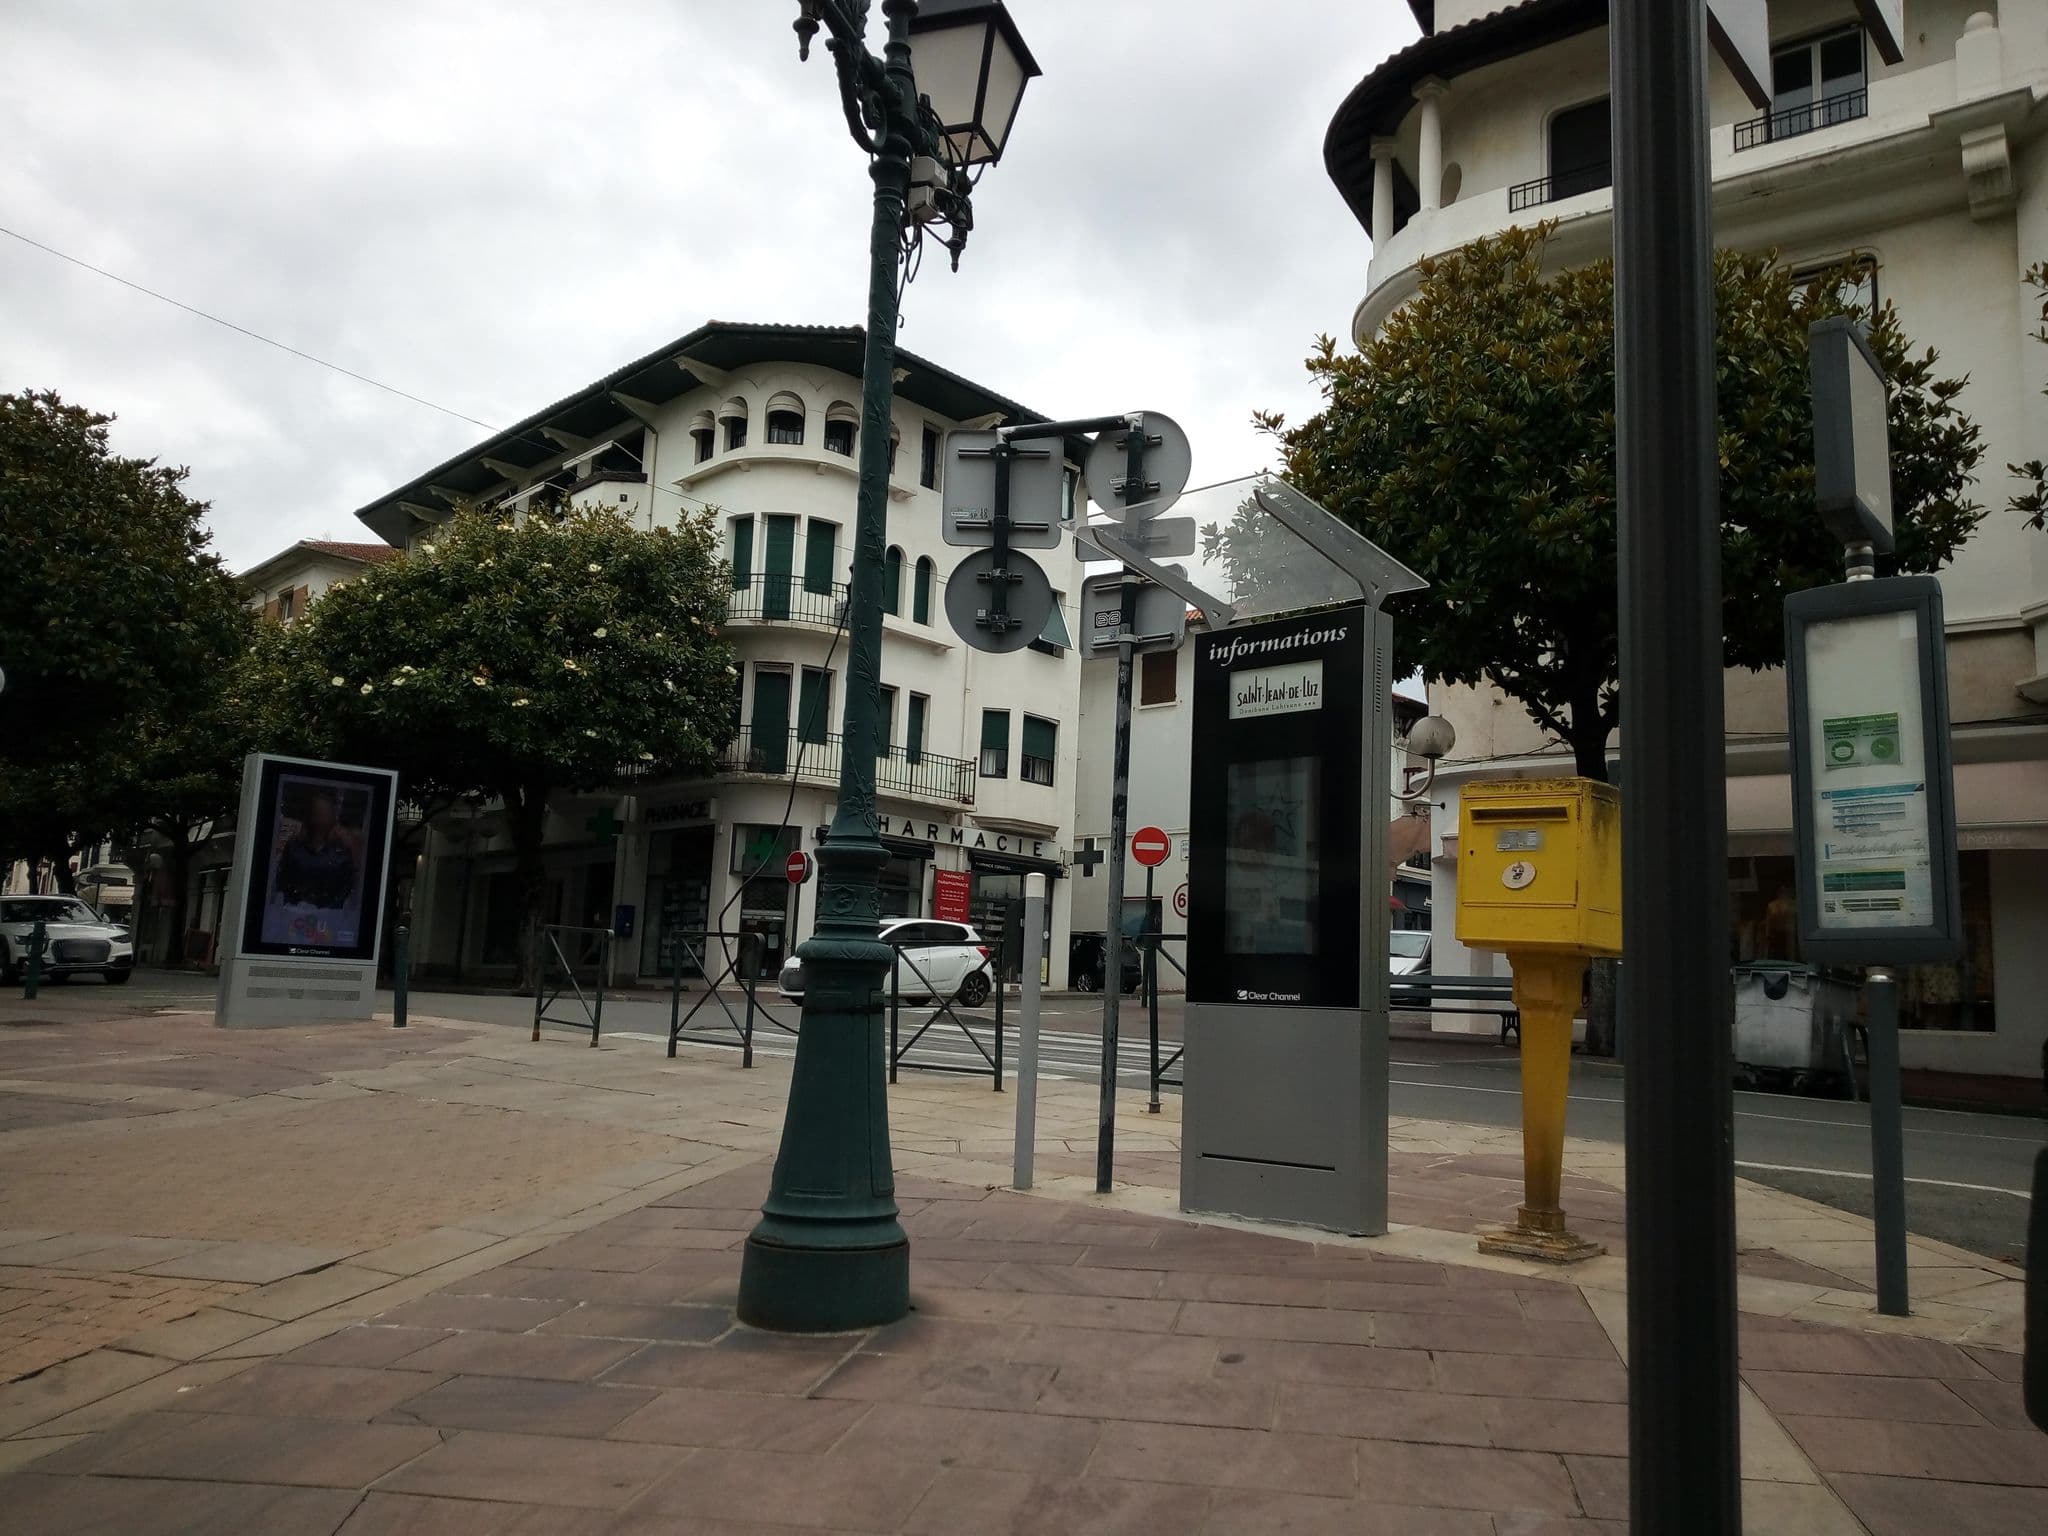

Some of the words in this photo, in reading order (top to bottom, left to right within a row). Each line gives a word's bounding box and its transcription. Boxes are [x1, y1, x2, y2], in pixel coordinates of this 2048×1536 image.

[1208, 626, 1348, 667] informations
[876, 816, 1044, 857] HARMACIE
[1248, 991, 1268, 1001] Clear
[1268, 991, 1300, 1001] Channel
